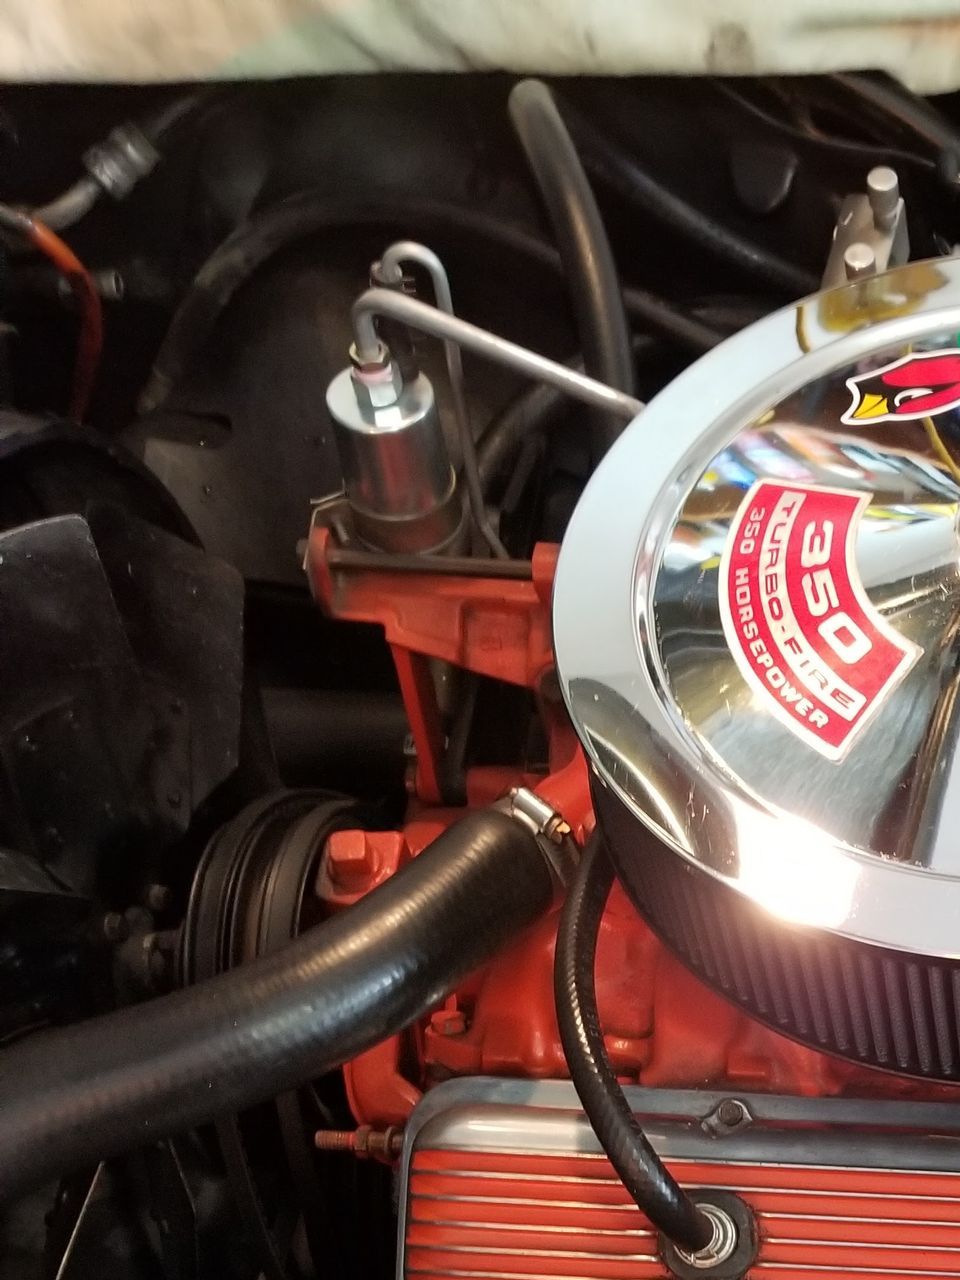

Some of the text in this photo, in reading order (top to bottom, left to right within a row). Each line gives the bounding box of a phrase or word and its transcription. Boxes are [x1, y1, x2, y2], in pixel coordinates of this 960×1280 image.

[735, 507, 829, 729] 350 HORSEPOWER
[763, 500, 856, 710] TURBO-FIRE
[801, 520, 872, 664] 350
